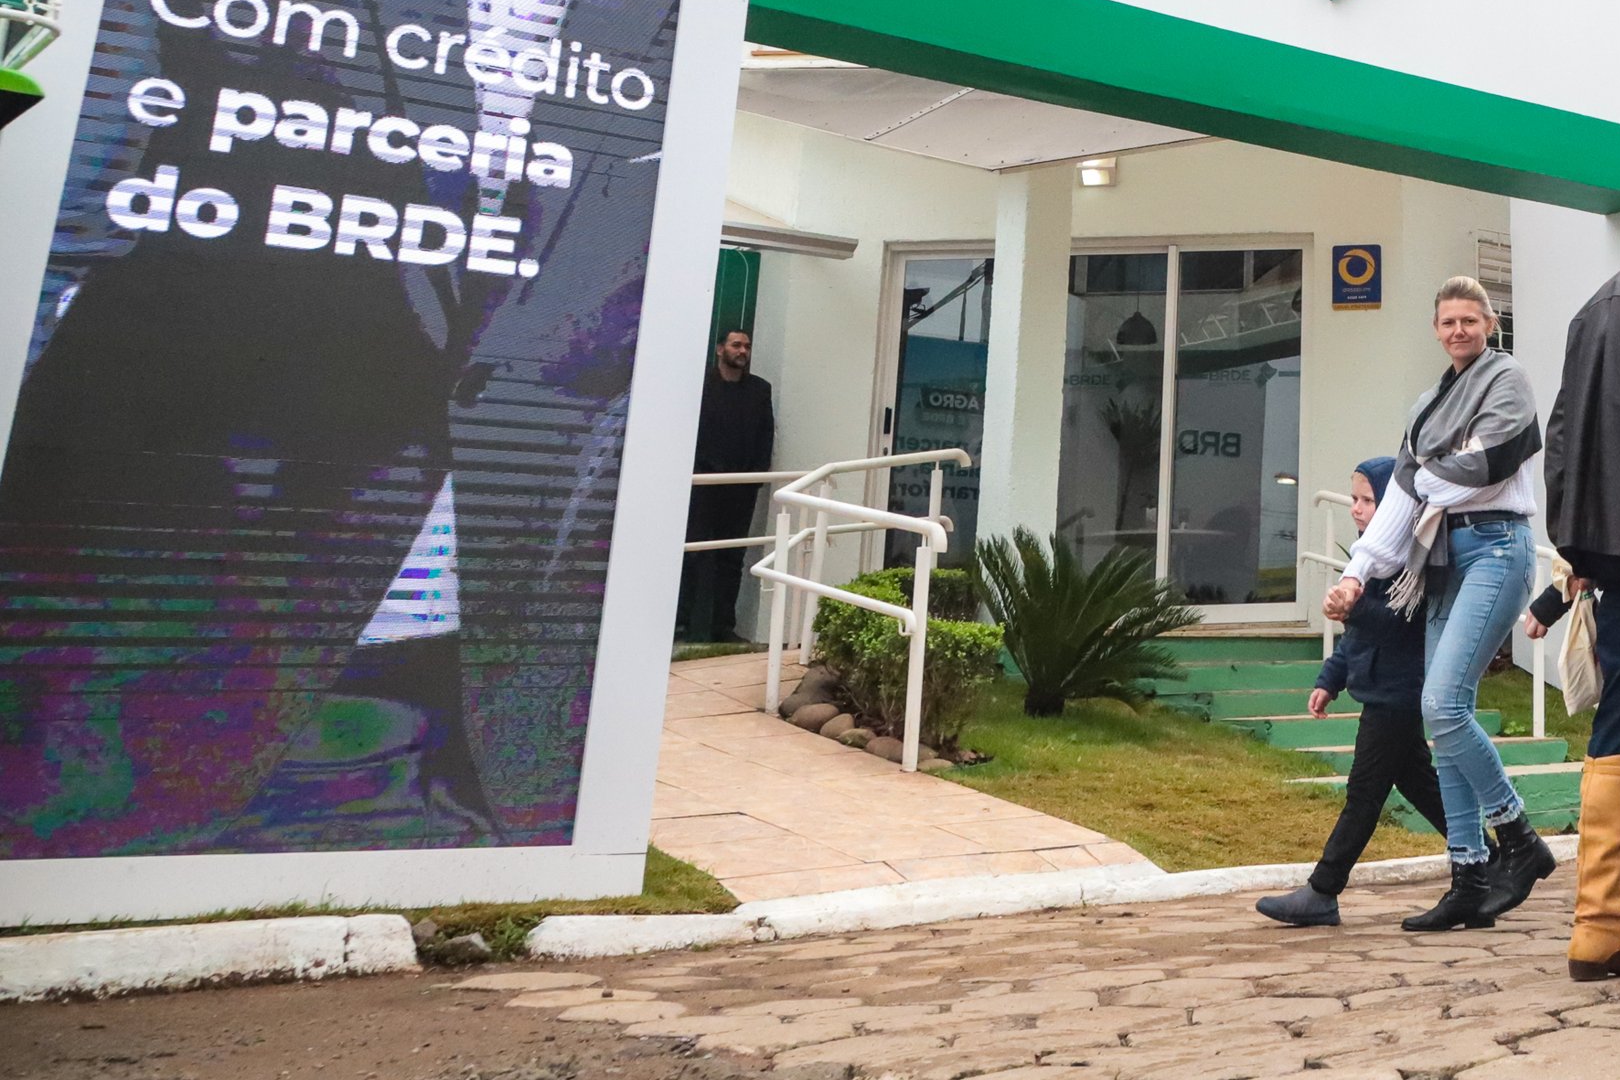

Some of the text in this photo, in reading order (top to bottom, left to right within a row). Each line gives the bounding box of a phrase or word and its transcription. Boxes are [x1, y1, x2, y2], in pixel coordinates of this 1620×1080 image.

[386, 24, 655, 110] crédito
[127, 77, 574, 189] e parceria
[106, 165, 540, 278] do BRDE.
